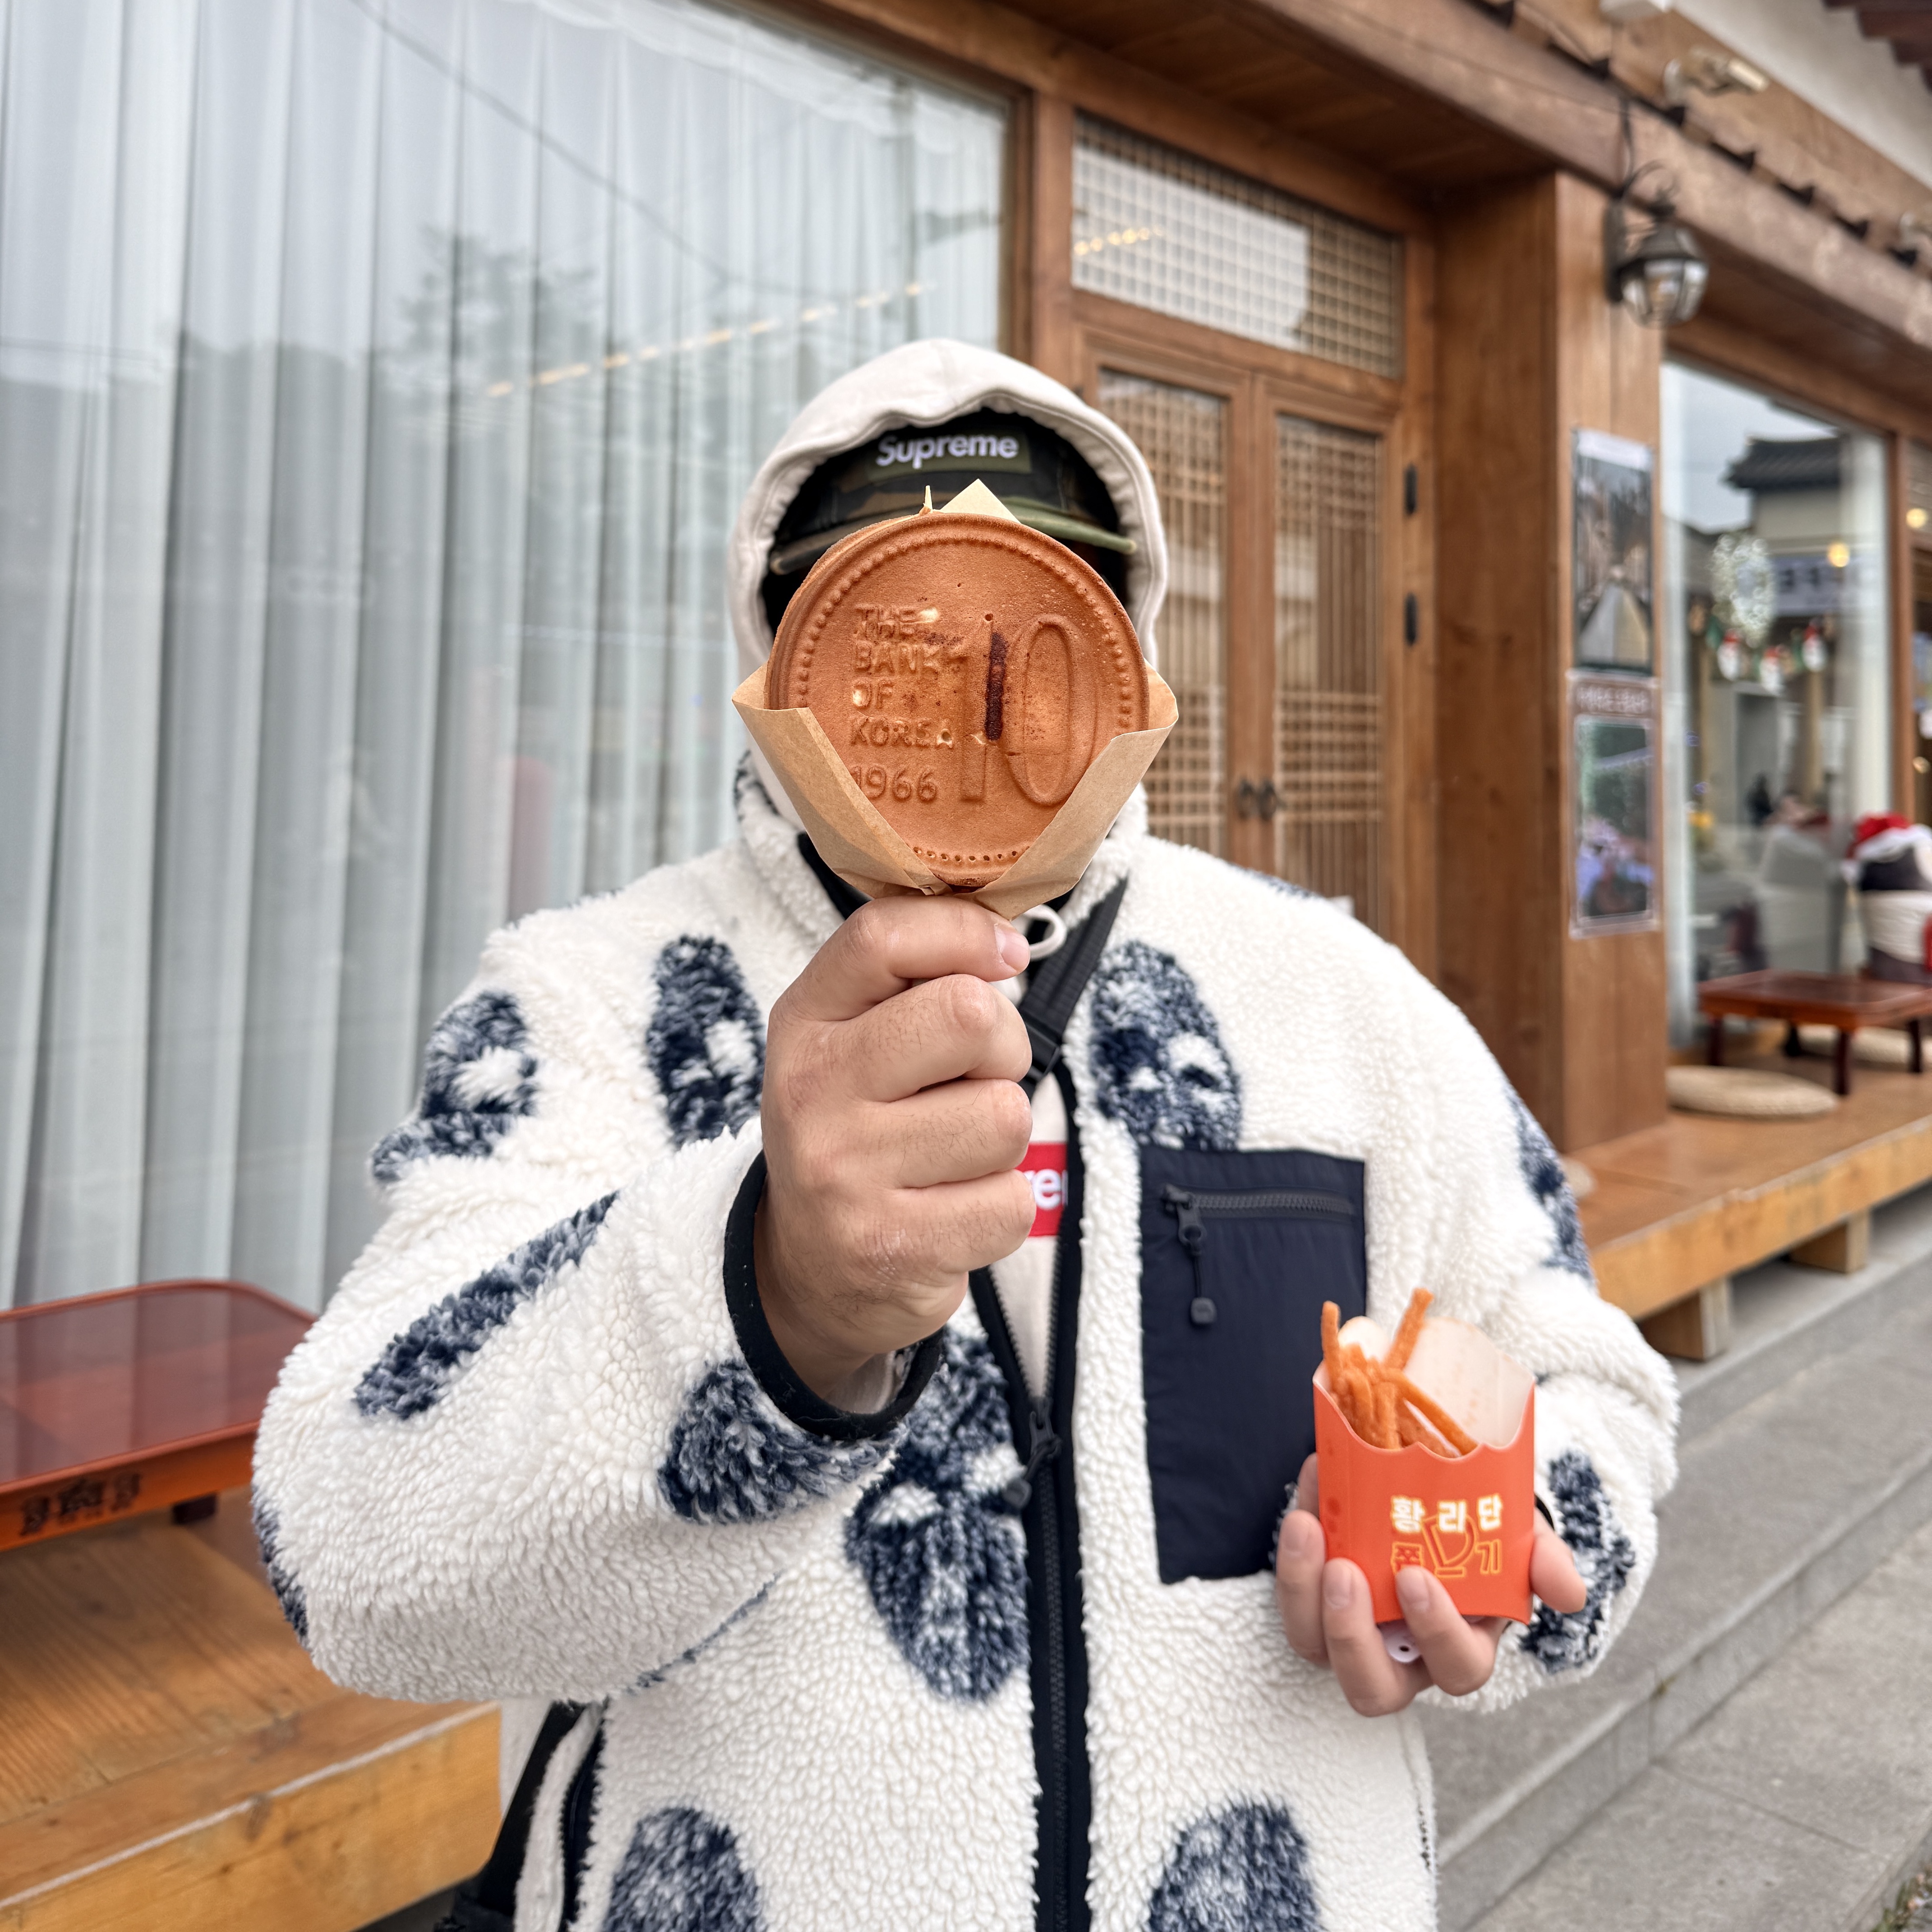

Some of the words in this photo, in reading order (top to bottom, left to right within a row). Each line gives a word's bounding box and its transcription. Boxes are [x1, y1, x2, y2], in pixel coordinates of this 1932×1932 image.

[876, 434, 1019, 469] Supreme
[854, 603, 917, 639] THE
[853, 641, 940, 674] BANK
[851, 677, 895, 709] OF
[947, 612, 1096, 807] 10
[850, 716, 953, 749] KOREA
[850, 763, 938, 802] 1966
[1391, 1493, 1503, 1533] 황리단
